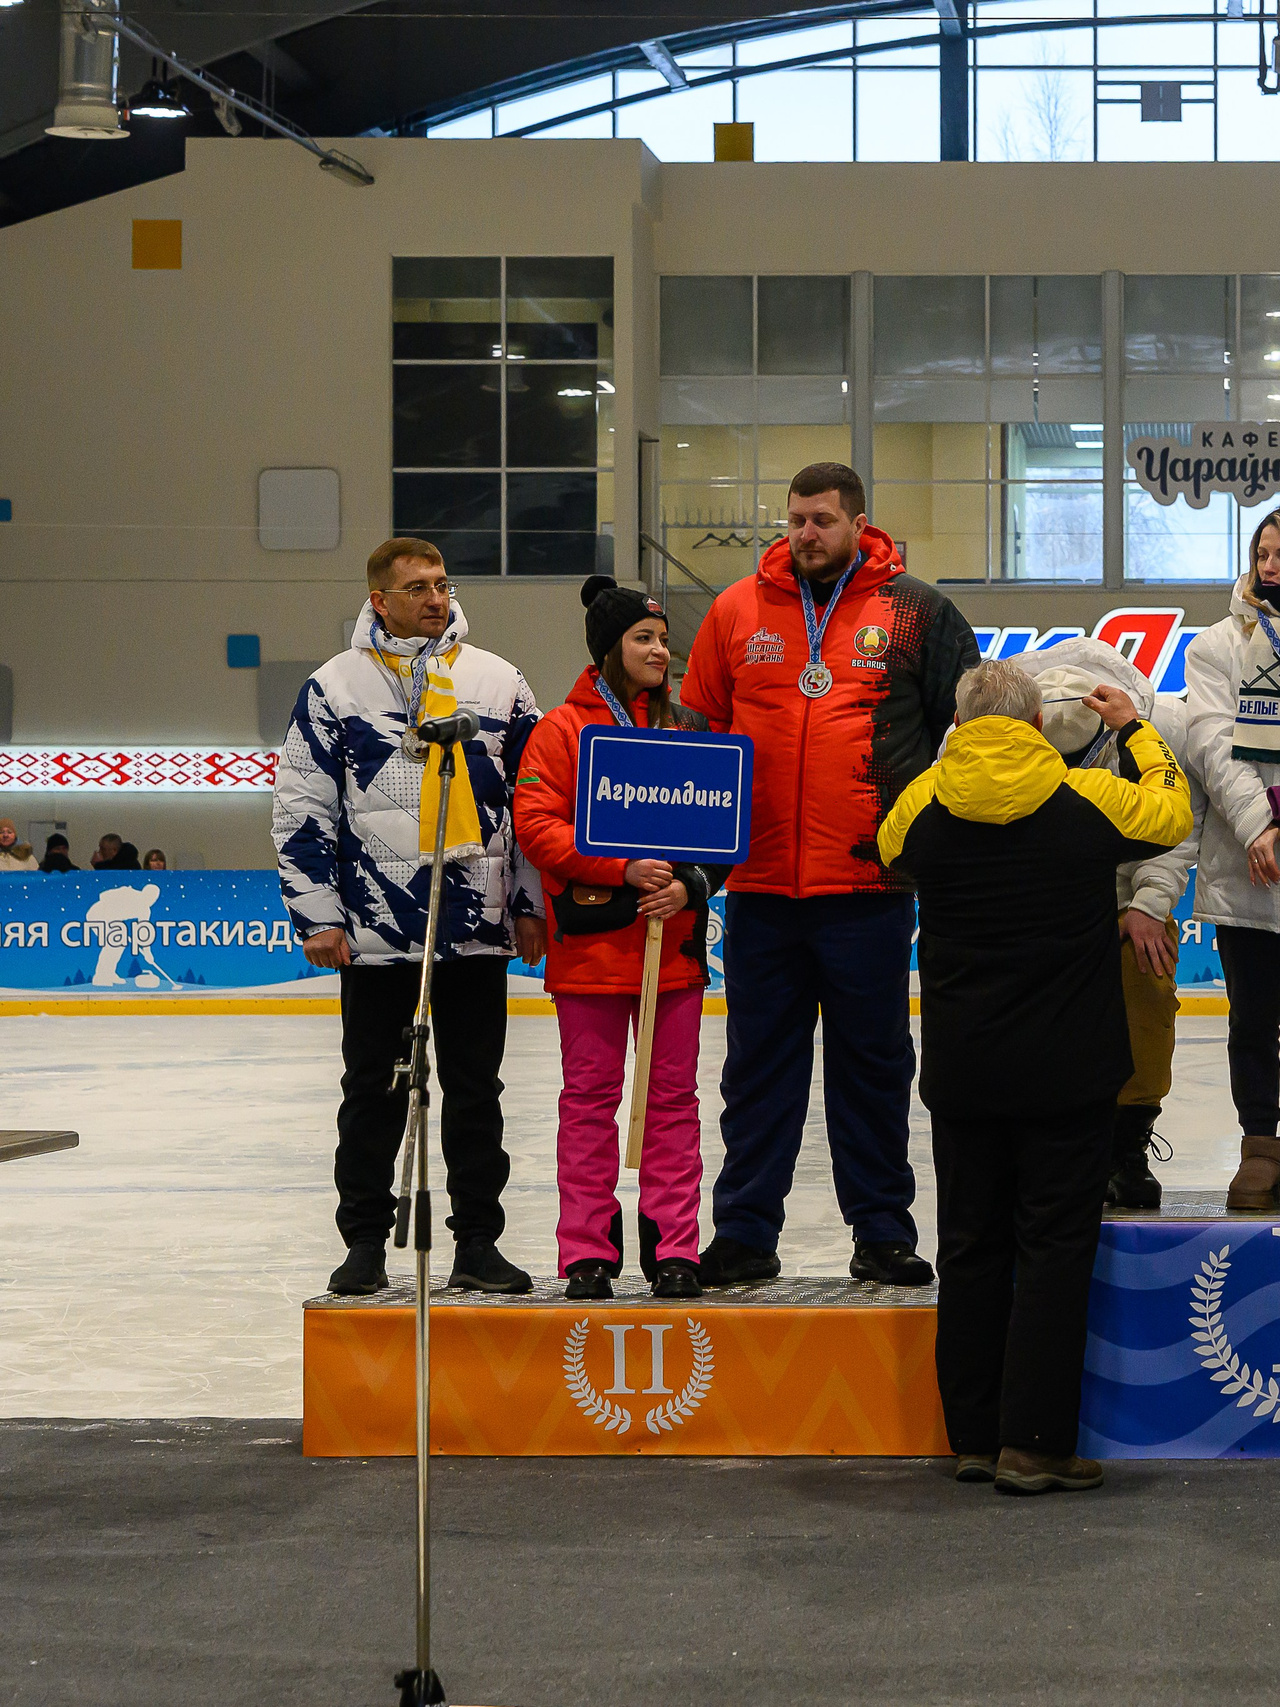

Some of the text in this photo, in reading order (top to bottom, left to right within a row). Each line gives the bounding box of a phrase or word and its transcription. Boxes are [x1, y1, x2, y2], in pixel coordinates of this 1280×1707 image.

[1201, 431, 1279, 448] КАФЕ
[1239, 700, 1279, 716] БЕЛЫЕ
[596, 775, 733, 810] Агрохолдинг
[0, 920, 49, 948] яя
[602, 1324, 674, 1395] II
